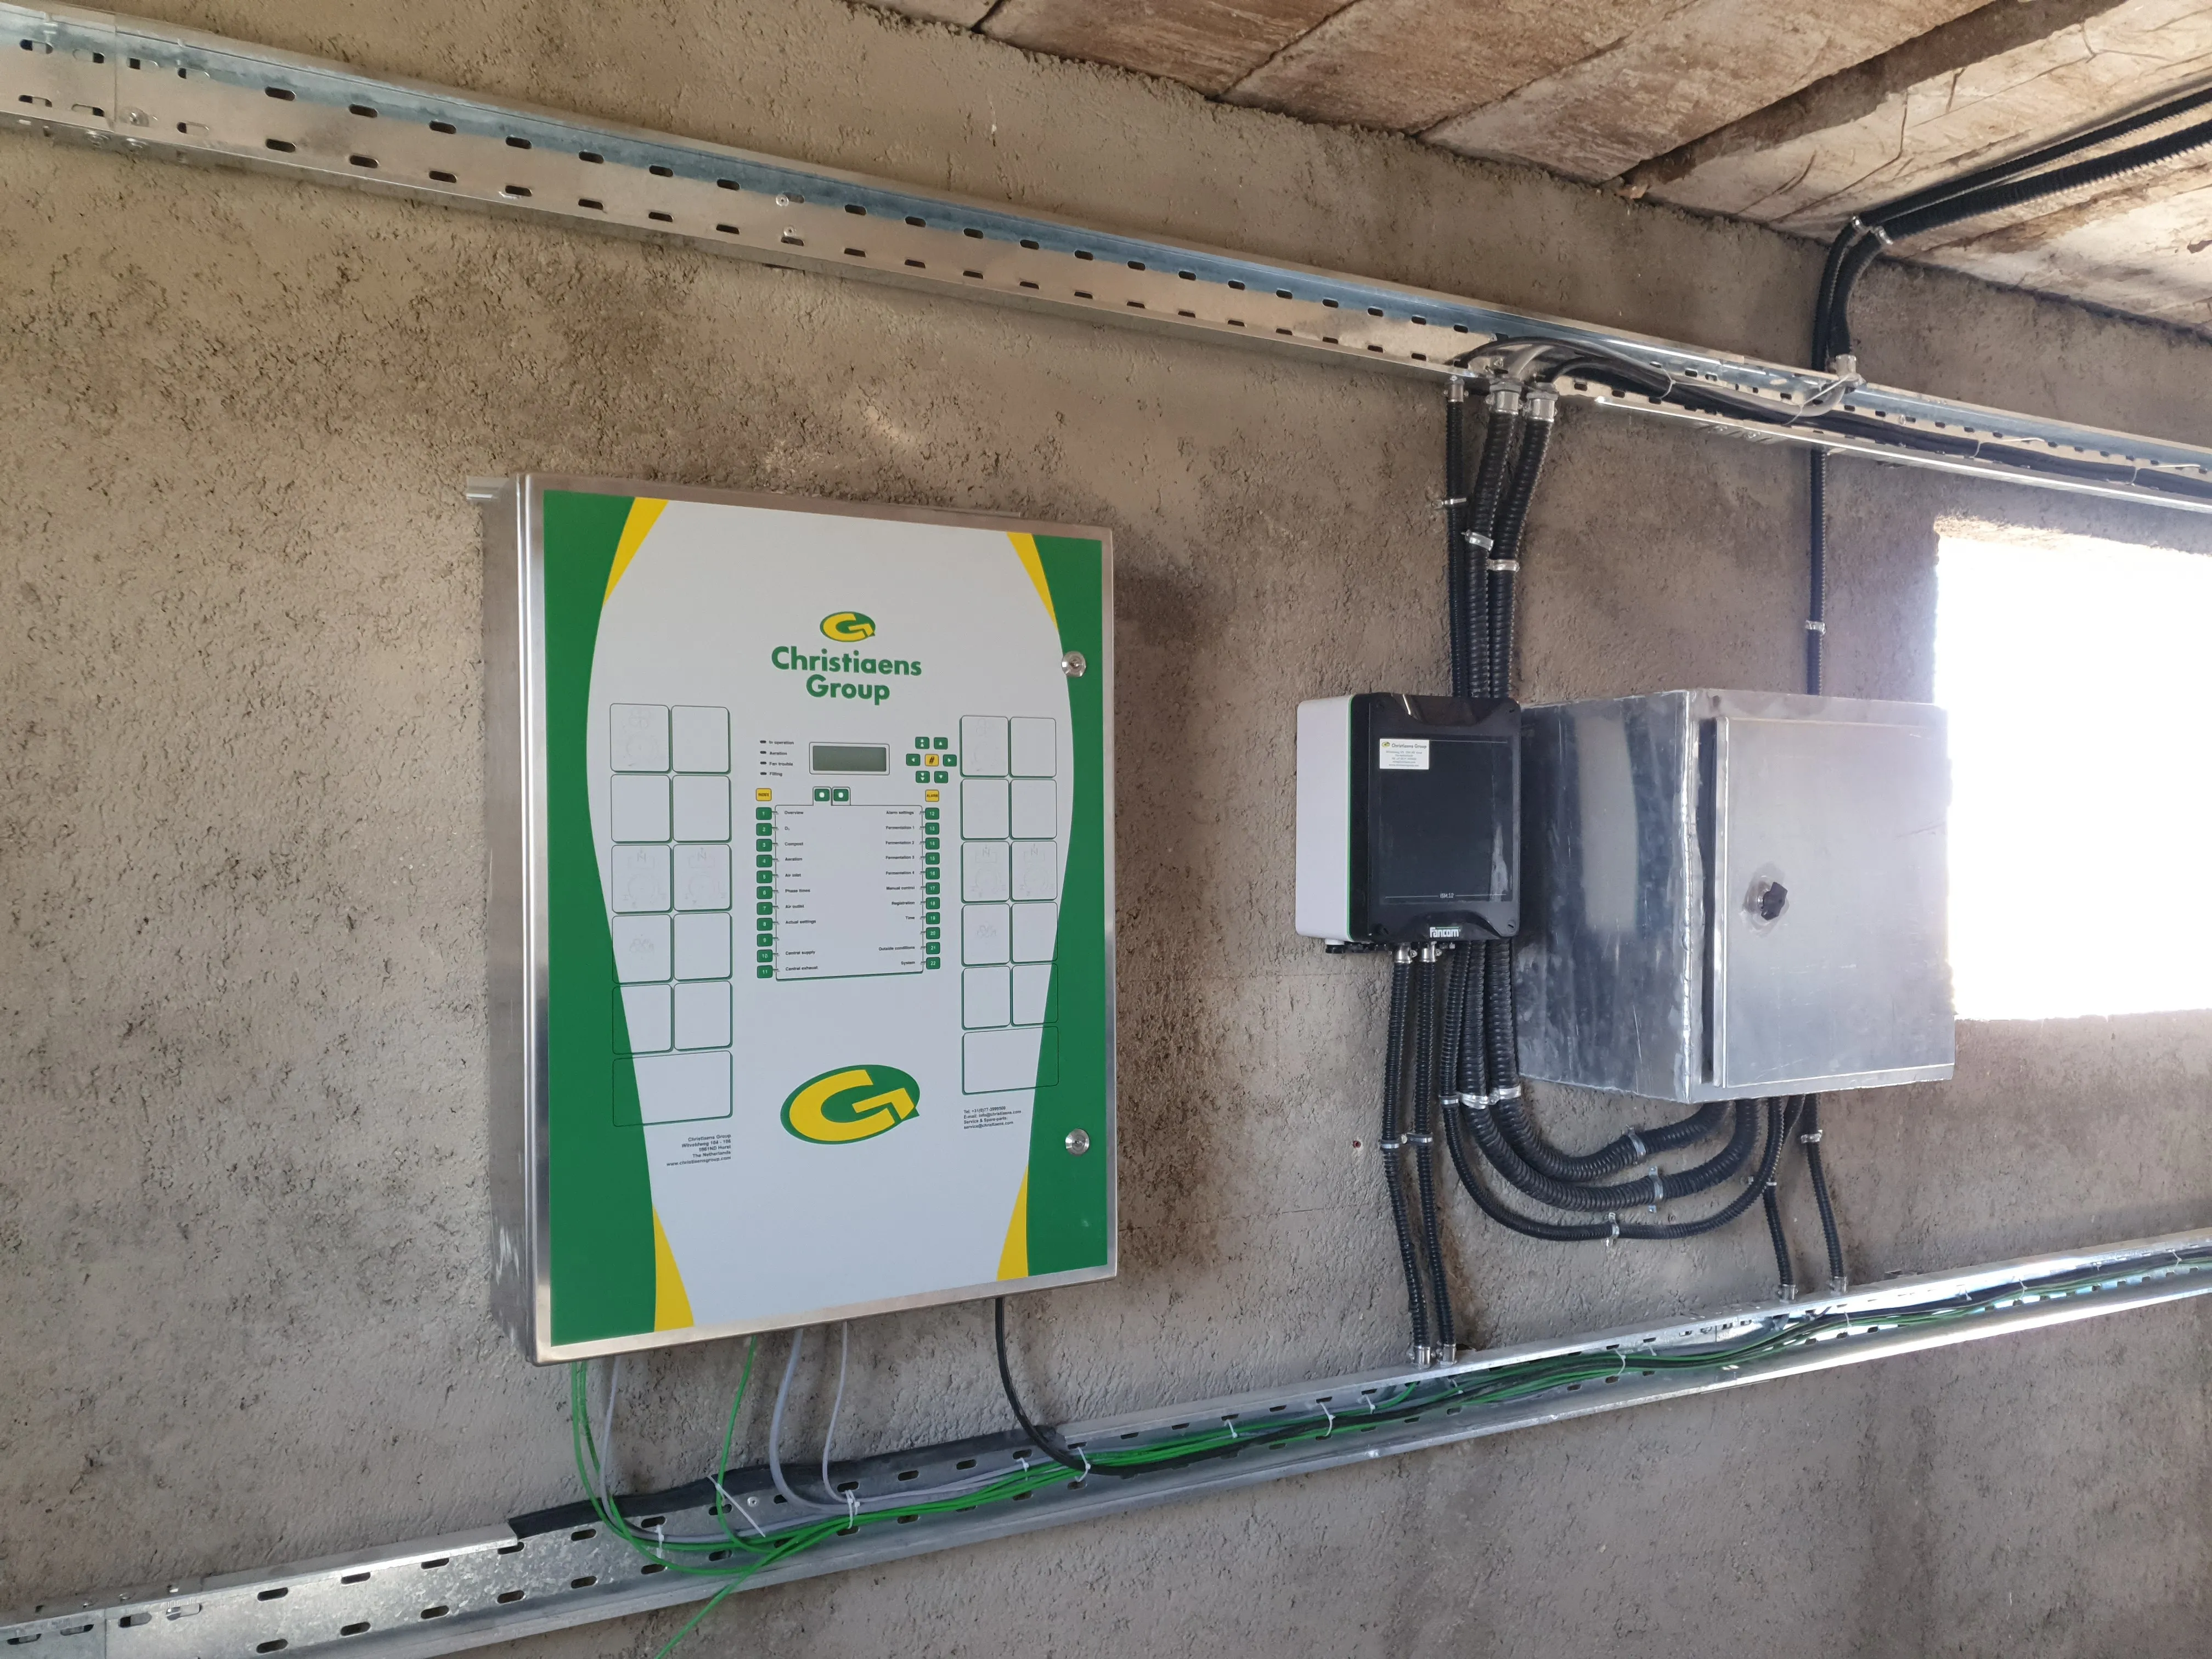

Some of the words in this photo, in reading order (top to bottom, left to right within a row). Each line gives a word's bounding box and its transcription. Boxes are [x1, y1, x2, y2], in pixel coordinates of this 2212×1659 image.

[771, 646, 922, 676] Christiaens
[806, 675, 890, 706] Group
[667, 1156, 731, 1166] www.christiaensgroup.com
